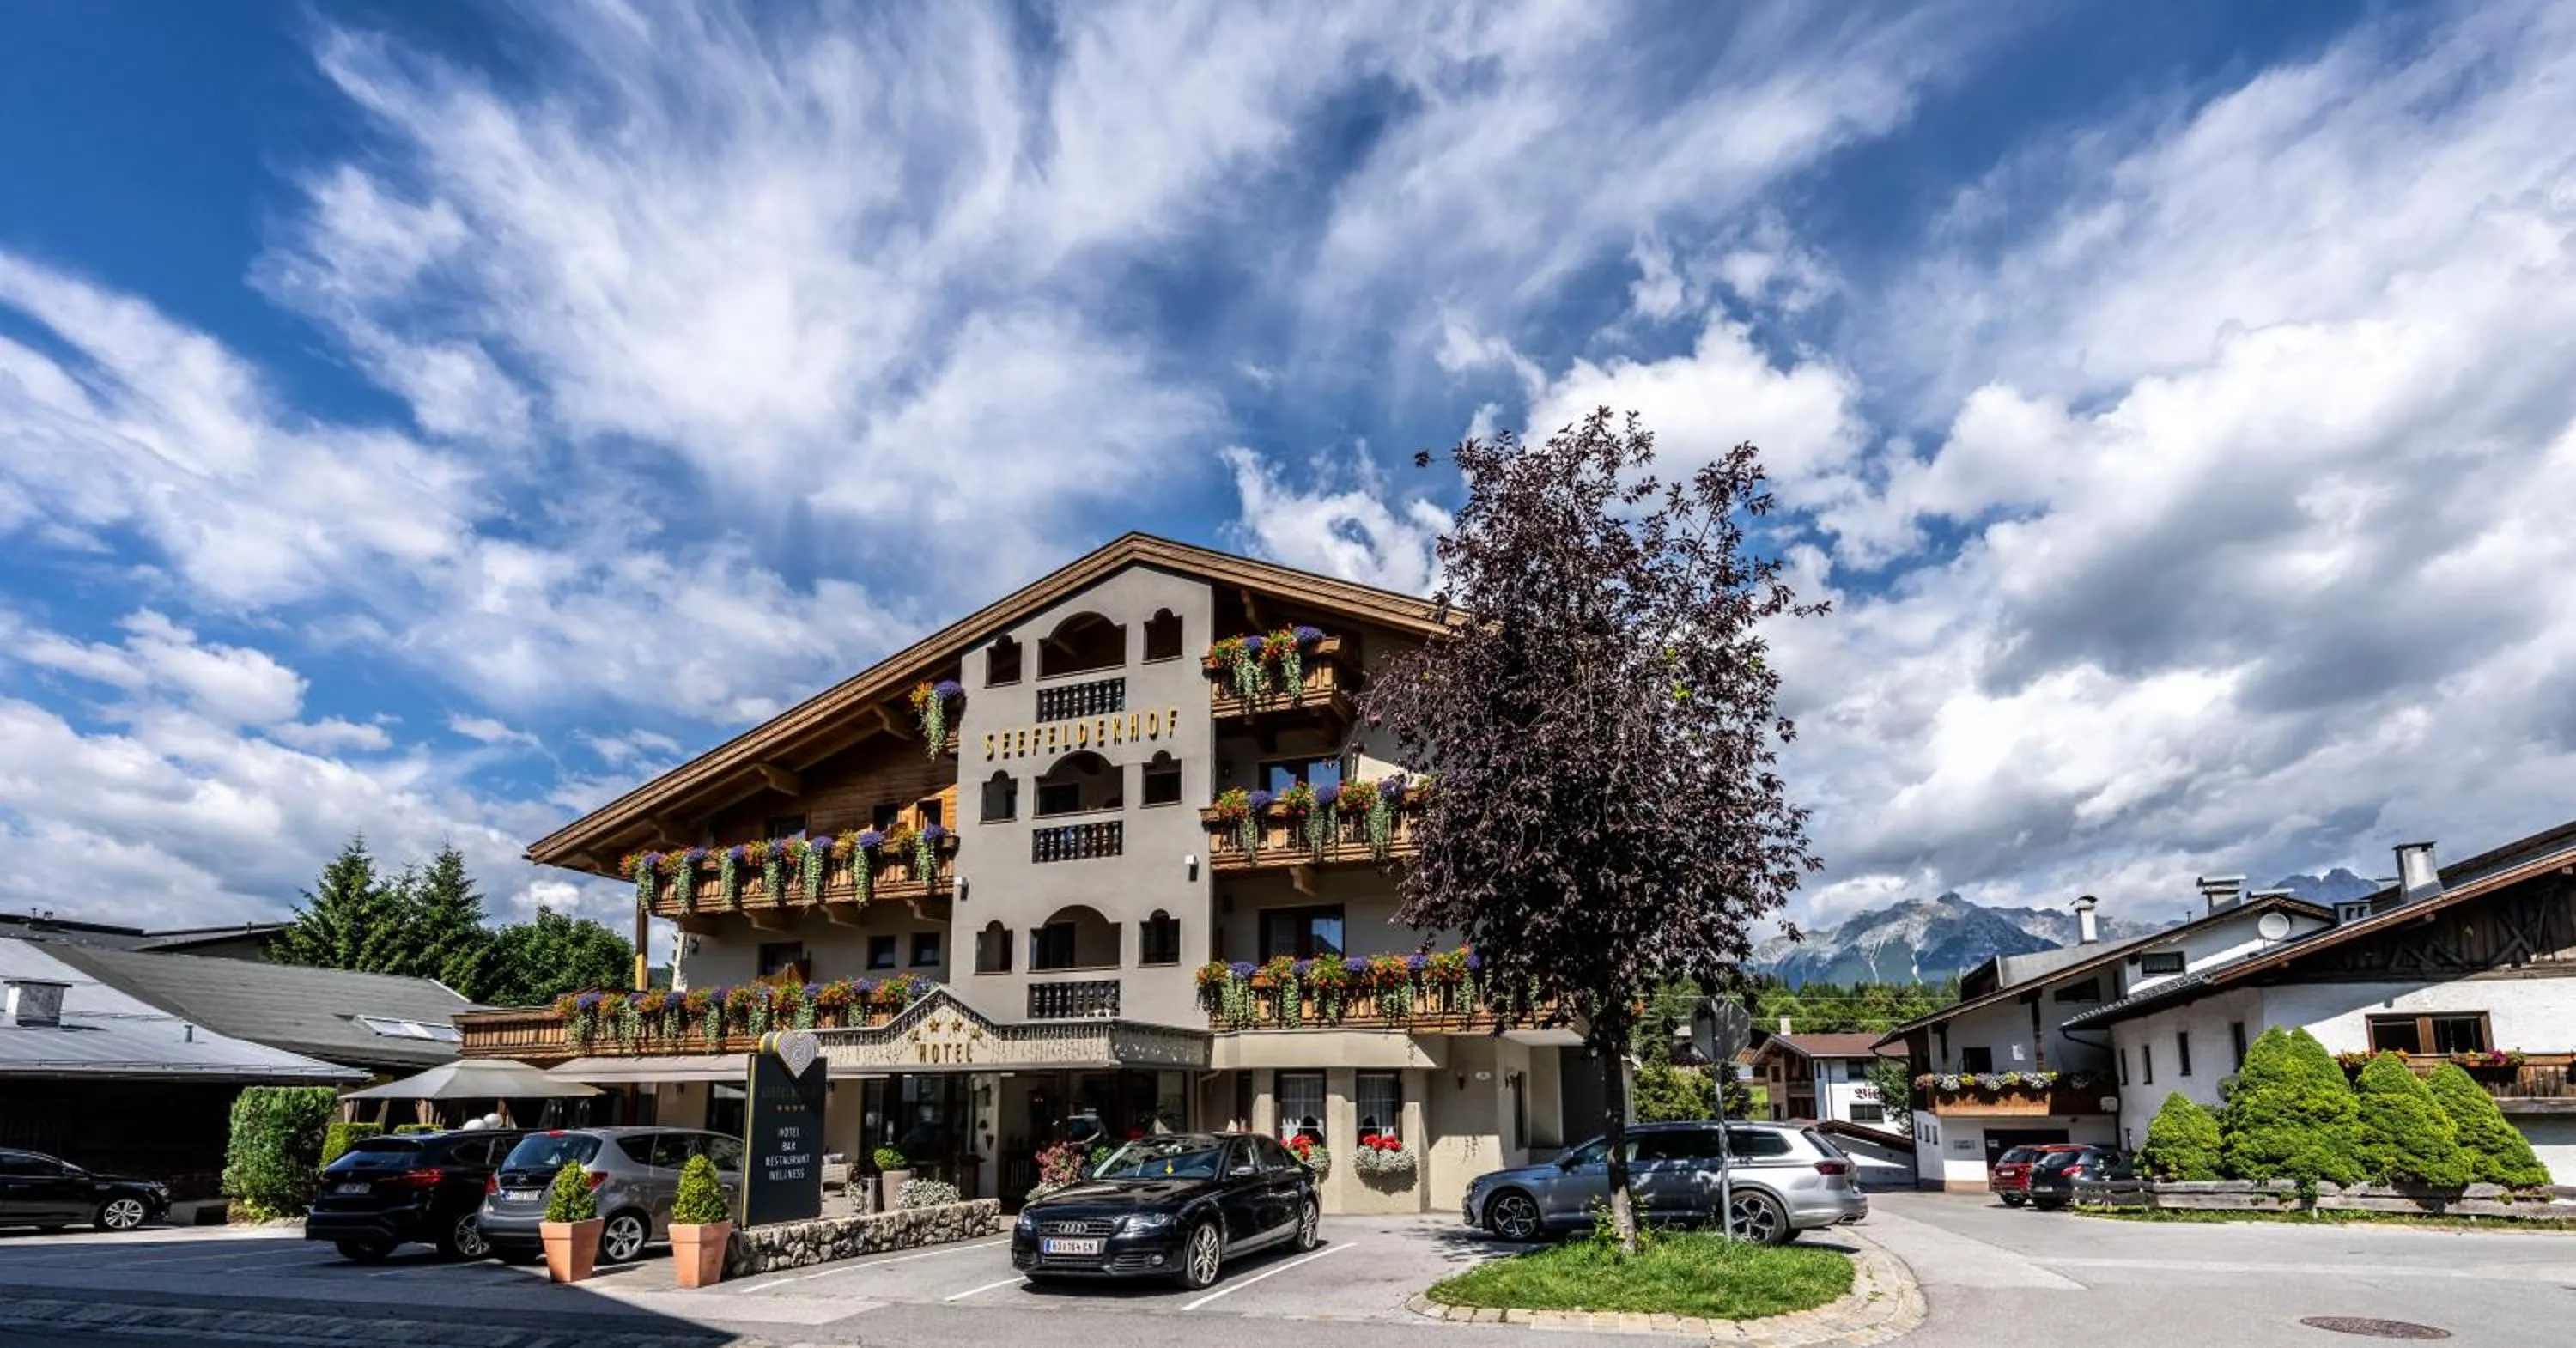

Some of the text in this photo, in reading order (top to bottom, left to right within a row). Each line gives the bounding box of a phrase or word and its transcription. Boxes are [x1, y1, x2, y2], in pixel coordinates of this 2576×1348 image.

[983, 706, 1177, 762] SEEFELDERHOF
[918, 1042, 973, 1064] HOTEL
[777, 1126, 799, 1138] HOTEL
[782, 1141, 796, 1151] BAR
[765, 1153, 810, 1167] RESTAURANT
[769, 1167, 805, 1181] WELLNESS
